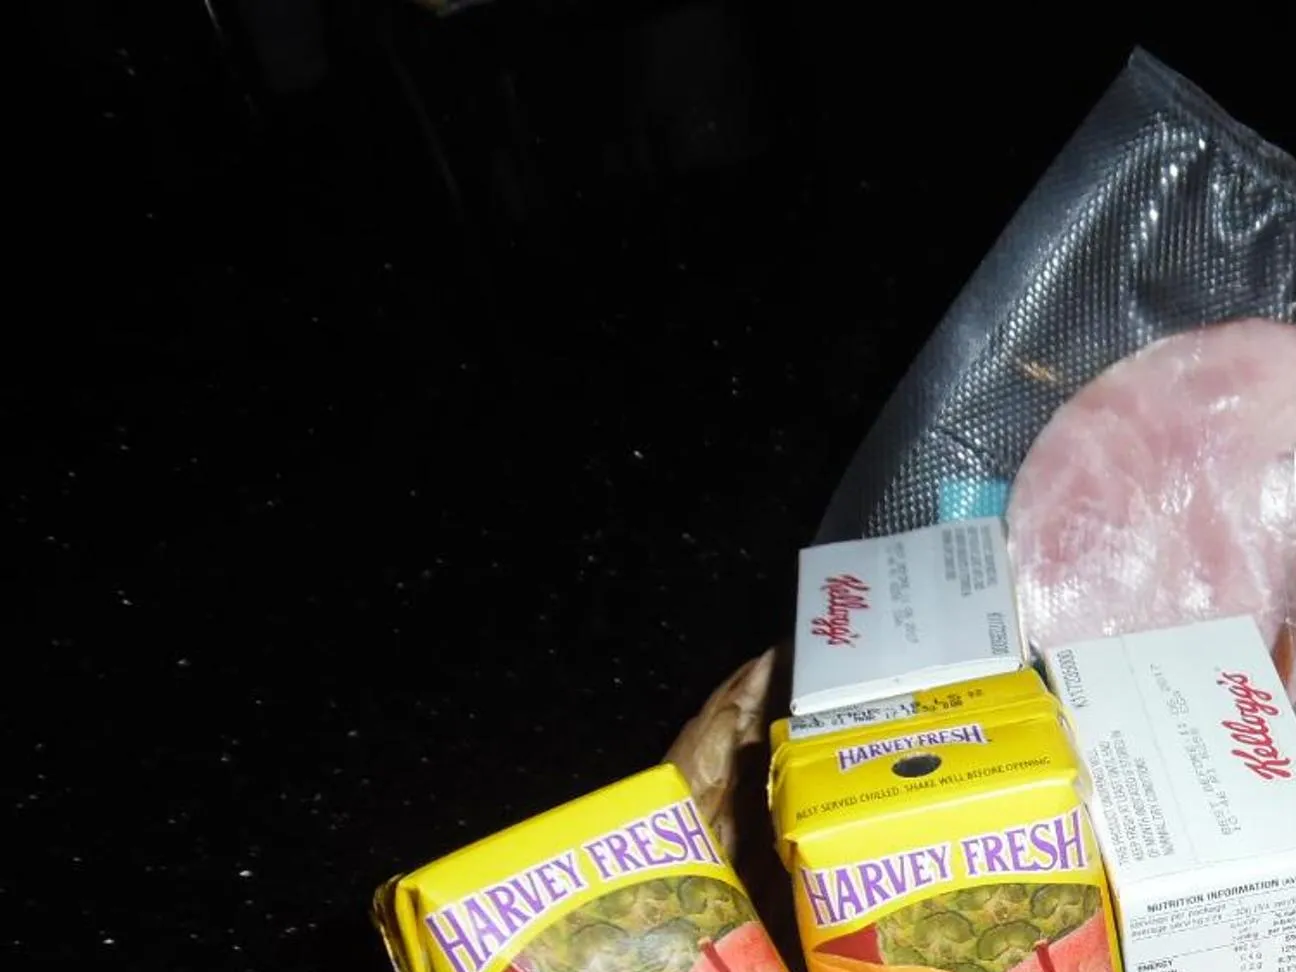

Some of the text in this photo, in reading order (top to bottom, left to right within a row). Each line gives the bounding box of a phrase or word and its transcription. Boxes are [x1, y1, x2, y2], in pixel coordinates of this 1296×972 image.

[811, 573, 872, 649] Kellogg's
[839, 725, 983, 769] HARVEY FRESH
[1216, 671, 1292, 780] Kellogg's
[587, 802, 719, 878] FRESH
[820, 795, 859, 813] SERVED
[801, 809, 1085, 926] HARVEY FRESH
[1147, 894, 1203, 913] NUTRITION
[1207, 879, 1278, 900] INFORMATION
